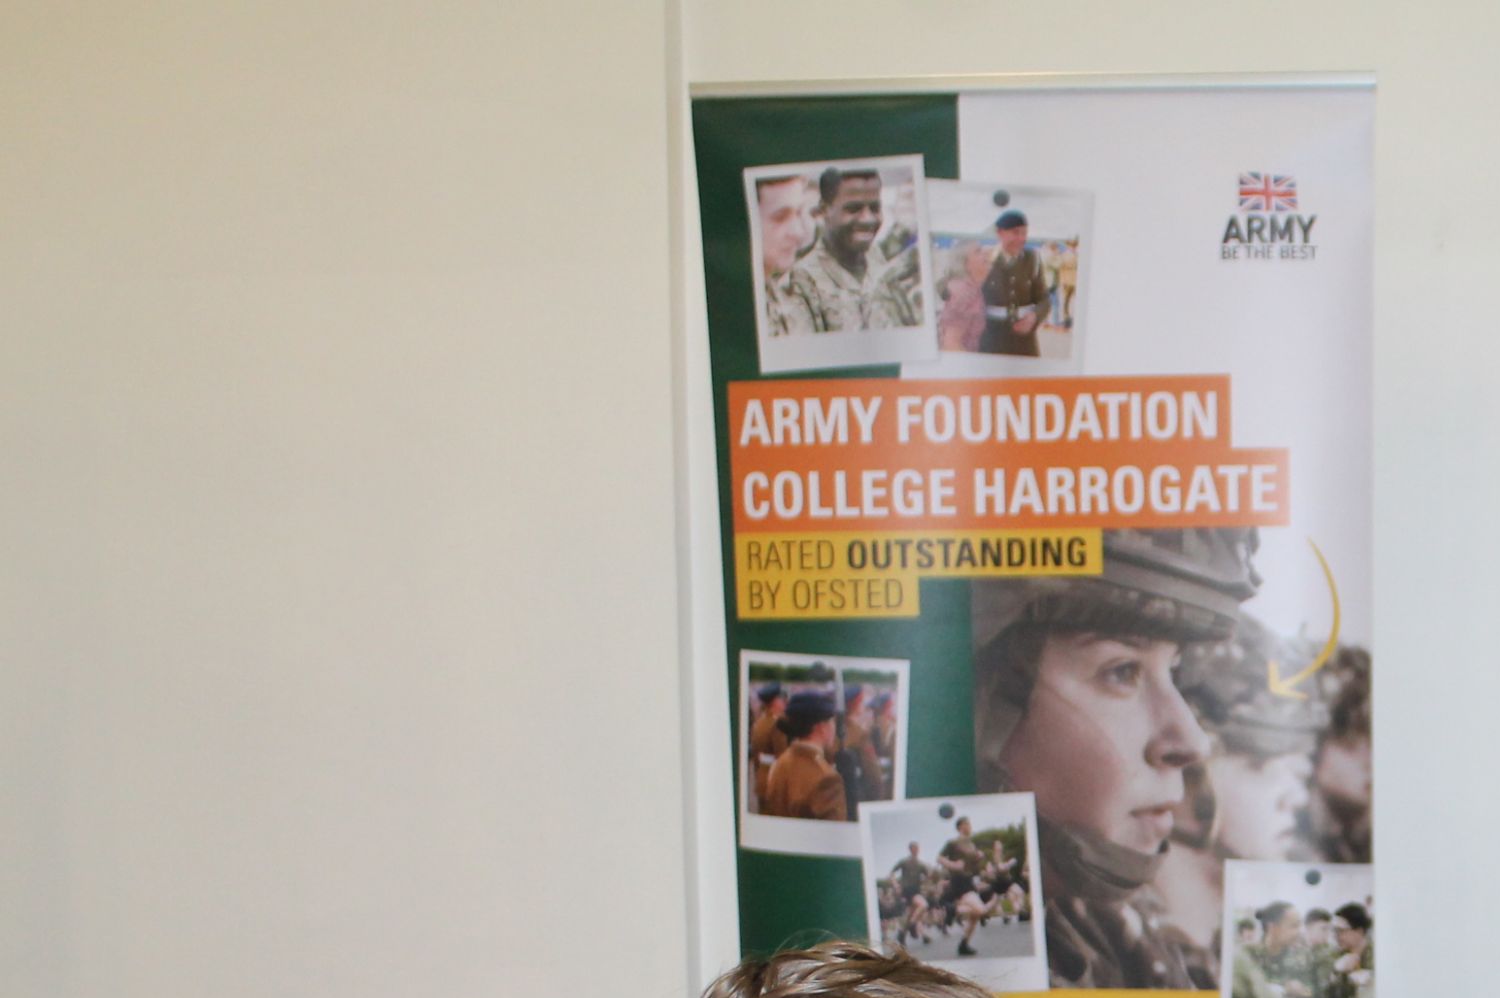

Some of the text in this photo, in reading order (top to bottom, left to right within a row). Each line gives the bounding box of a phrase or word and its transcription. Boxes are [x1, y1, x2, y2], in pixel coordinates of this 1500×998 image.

[1222, 213, 1317, 243] ARMY
[1221, 245, 1318, 260] BE THE BEST
[739, 391, 1218, 446] ARMY FOUNDATION
[743, 464, 1279, 519] COLLEGE HARROGATE
[747, 536, 1087, 571] RATED OUTSTANDING
[748, 577, 904, 610] BY OFSTED
